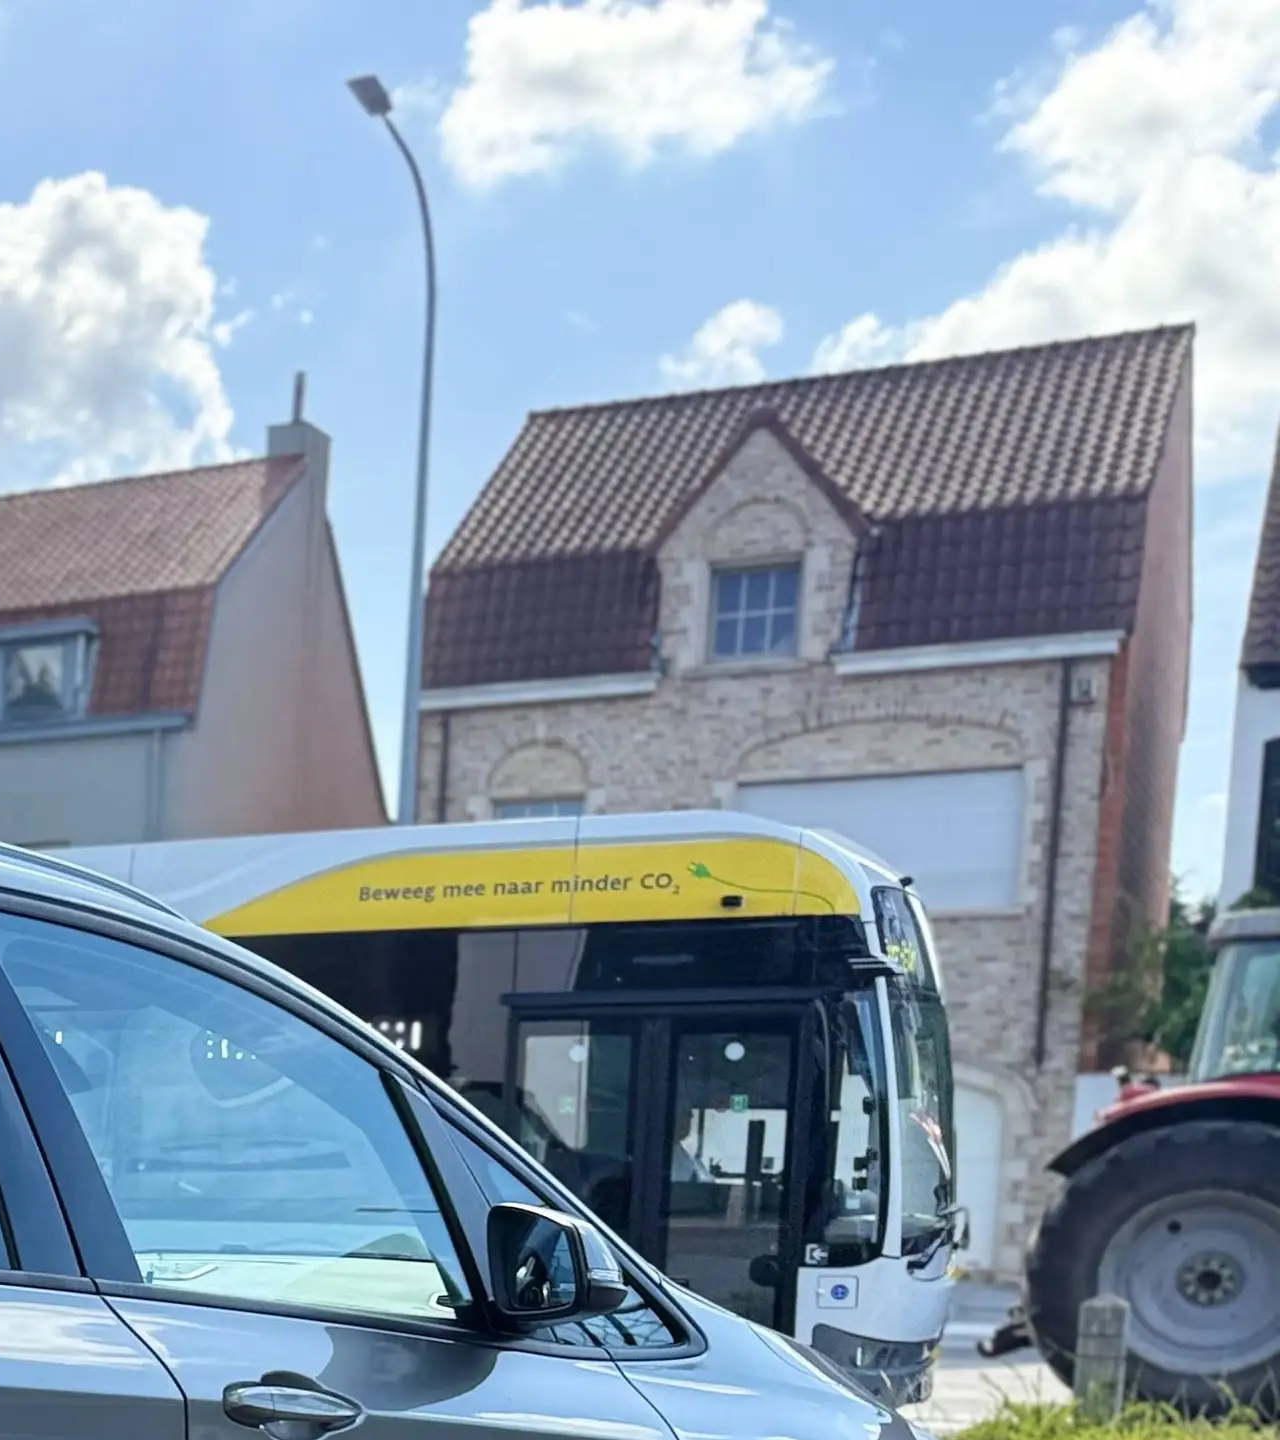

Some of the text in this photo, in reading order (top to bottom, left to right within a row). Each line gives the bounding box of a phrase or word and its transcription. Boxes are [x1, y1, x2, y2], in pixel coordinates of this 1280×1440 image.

[358, 886, 436, 903] Beweeg
[442, 883, 486, 898] mee
[493, 880, 545, 896] naar
[551, 874, 632, 893] minder
